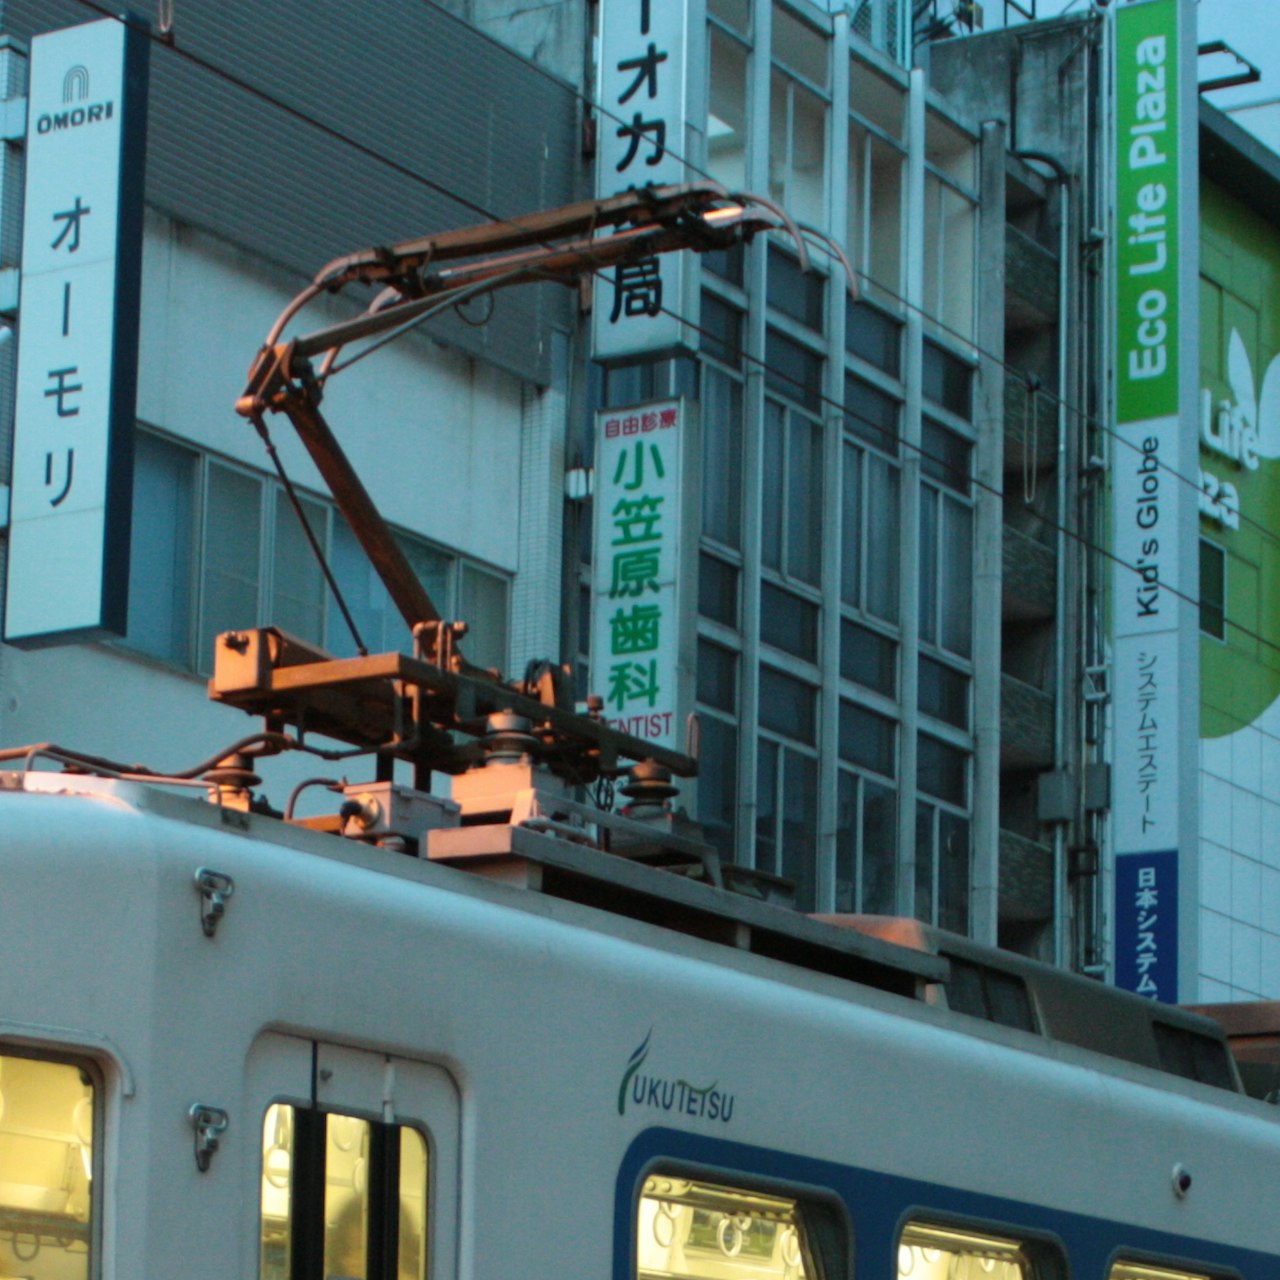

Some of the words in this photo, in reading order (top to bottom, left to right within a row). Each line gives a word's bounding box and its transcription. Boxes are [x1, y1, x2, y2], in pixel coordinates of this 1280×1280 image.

[37, 100, 114, 136] OMORI
[1128, 35, 1167, 171] Plaza
[609, 0, 668, 325] ーオカ局
[1128, 183, 1167, 277] Life
[43, 197, 91, 508] オーモリ
[1128, 289, 1167, 381] Eco
[1200, 388, 1260, 471] Life
[1136, 436, 1160, 532] Globe
[608, 440, 665, 713] 小笠原歯科
[1136, 541, 1160, 618] Kid's
[1136, 652, 1159, 834] システムエステート
[1135, 867, 1159, 1001] 日本システム
[617, 1025, 734, 1123] FUKUTETSU
